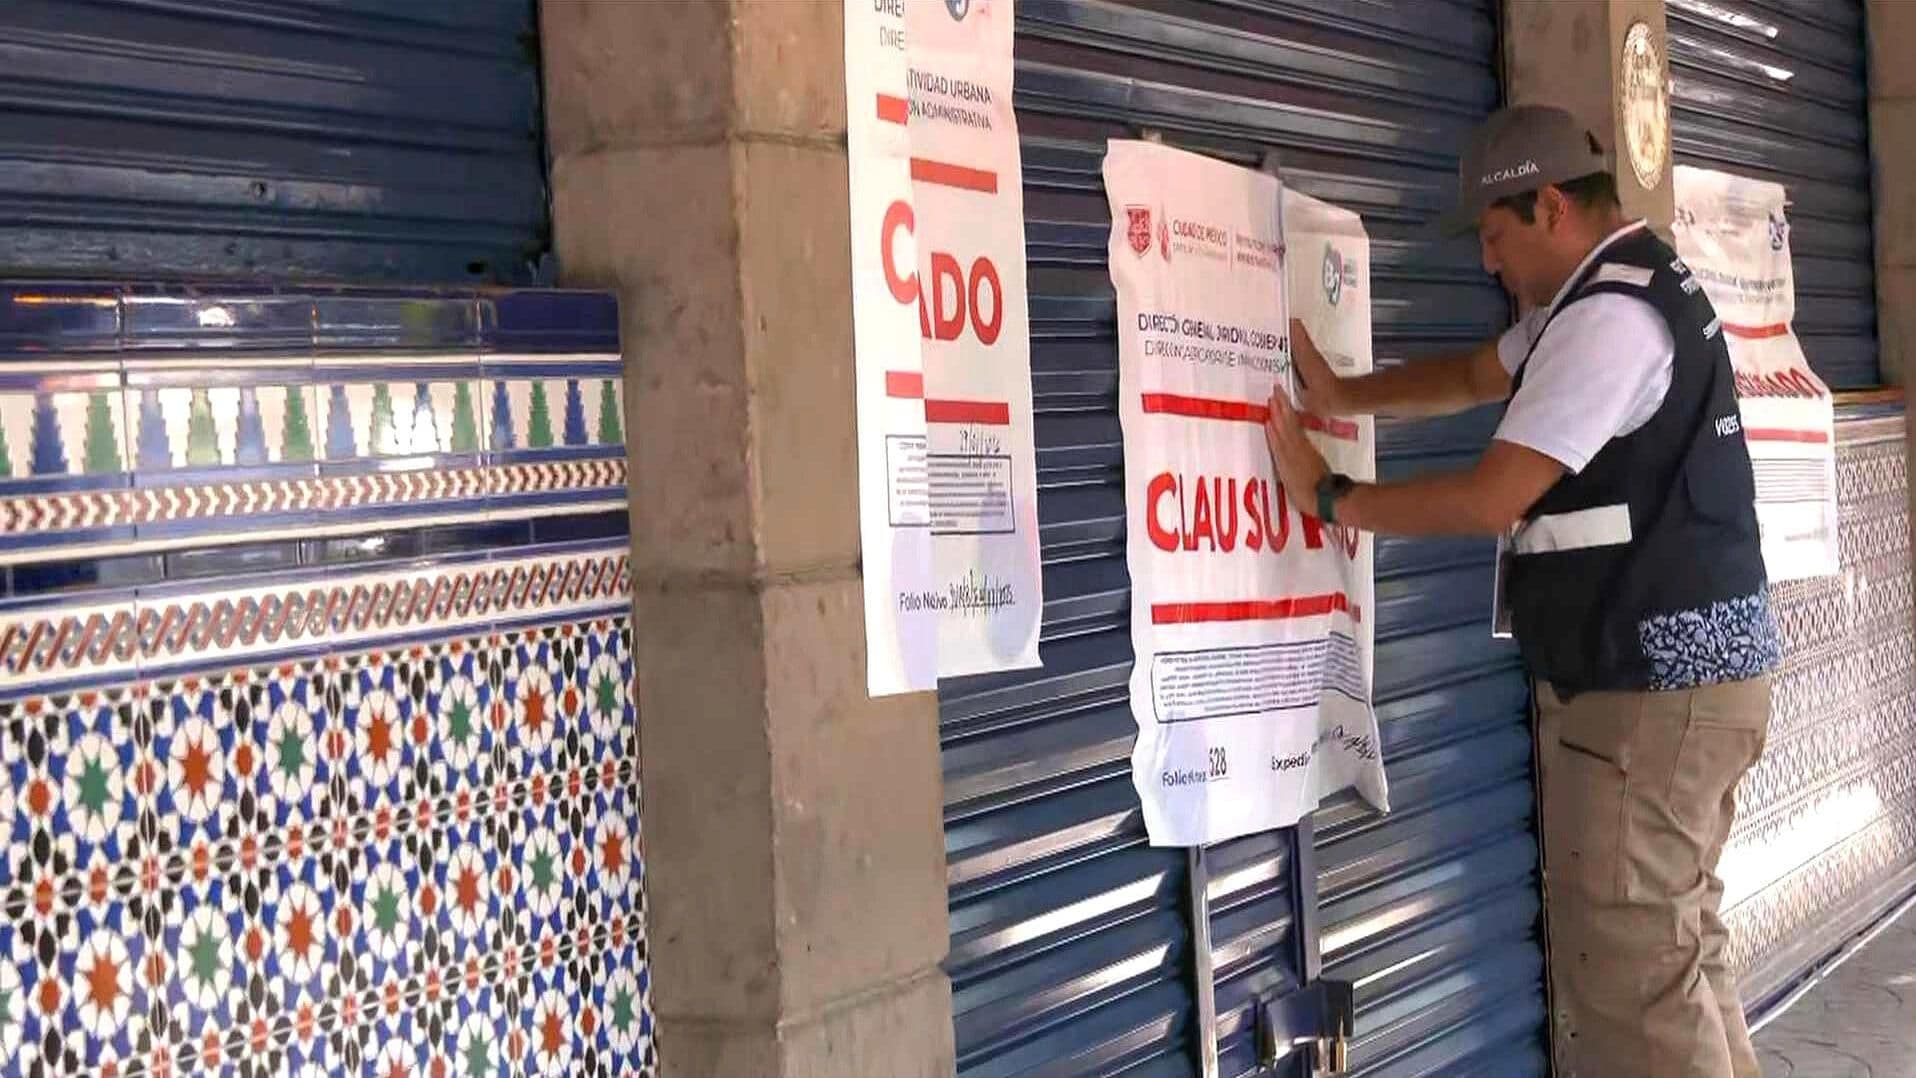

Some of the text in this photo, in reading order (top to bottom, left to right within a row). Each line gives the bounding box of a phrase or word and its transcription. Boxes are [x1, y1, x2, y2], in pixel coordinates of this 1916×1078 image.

[949, 79, 993, 105] URBANA
[921, 101, 993, 131] ADMINISTRATIVA
[1480, 159, 1541, 185] ALCALDÍA
